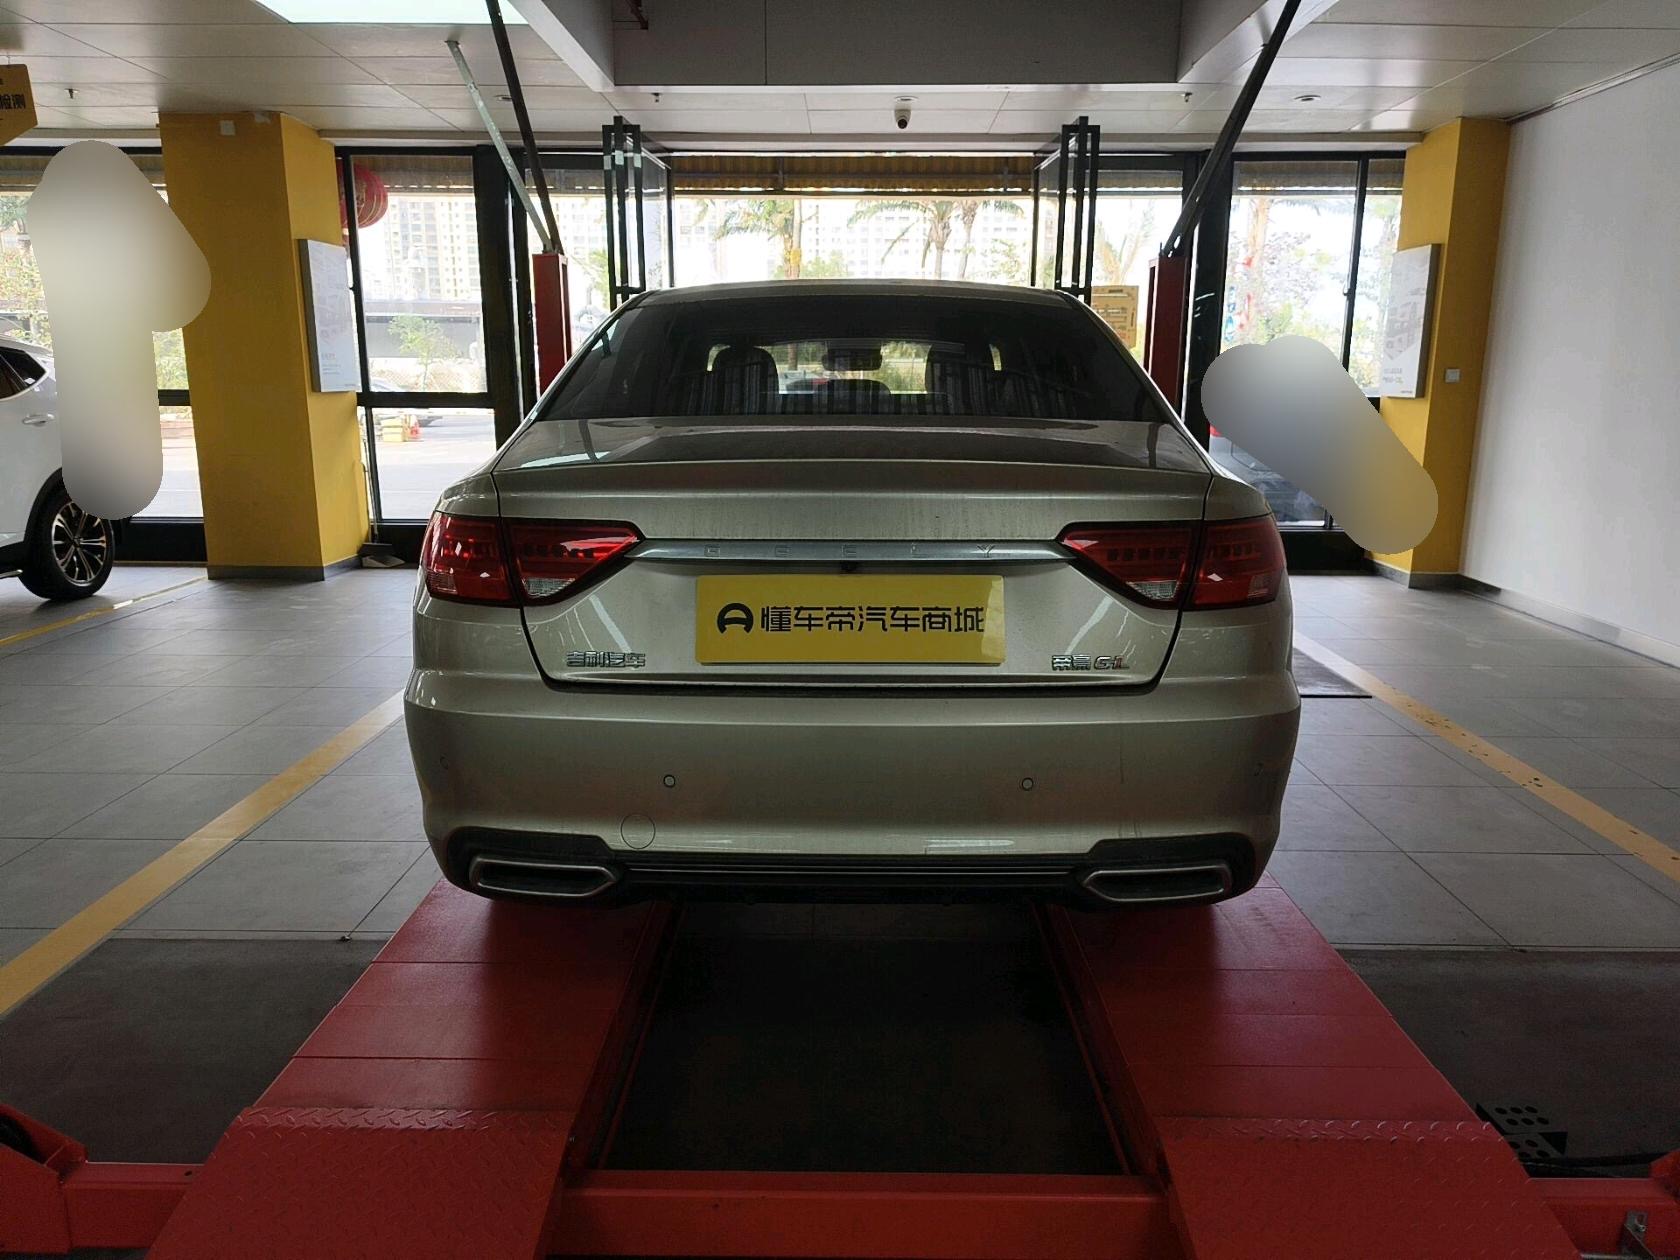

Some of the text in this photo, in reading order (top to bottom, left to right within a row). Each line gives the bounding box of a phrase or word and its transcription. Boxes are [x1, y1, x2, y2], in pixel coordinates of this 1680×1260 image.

[703, 543, 996, 558] GEELY
[760, 606, 985, 633] 懂车帝汽车商城
[566, 650, 646, 669] 吉利汽车
[1052, 654, 1130, 671] 帝豪 GL
